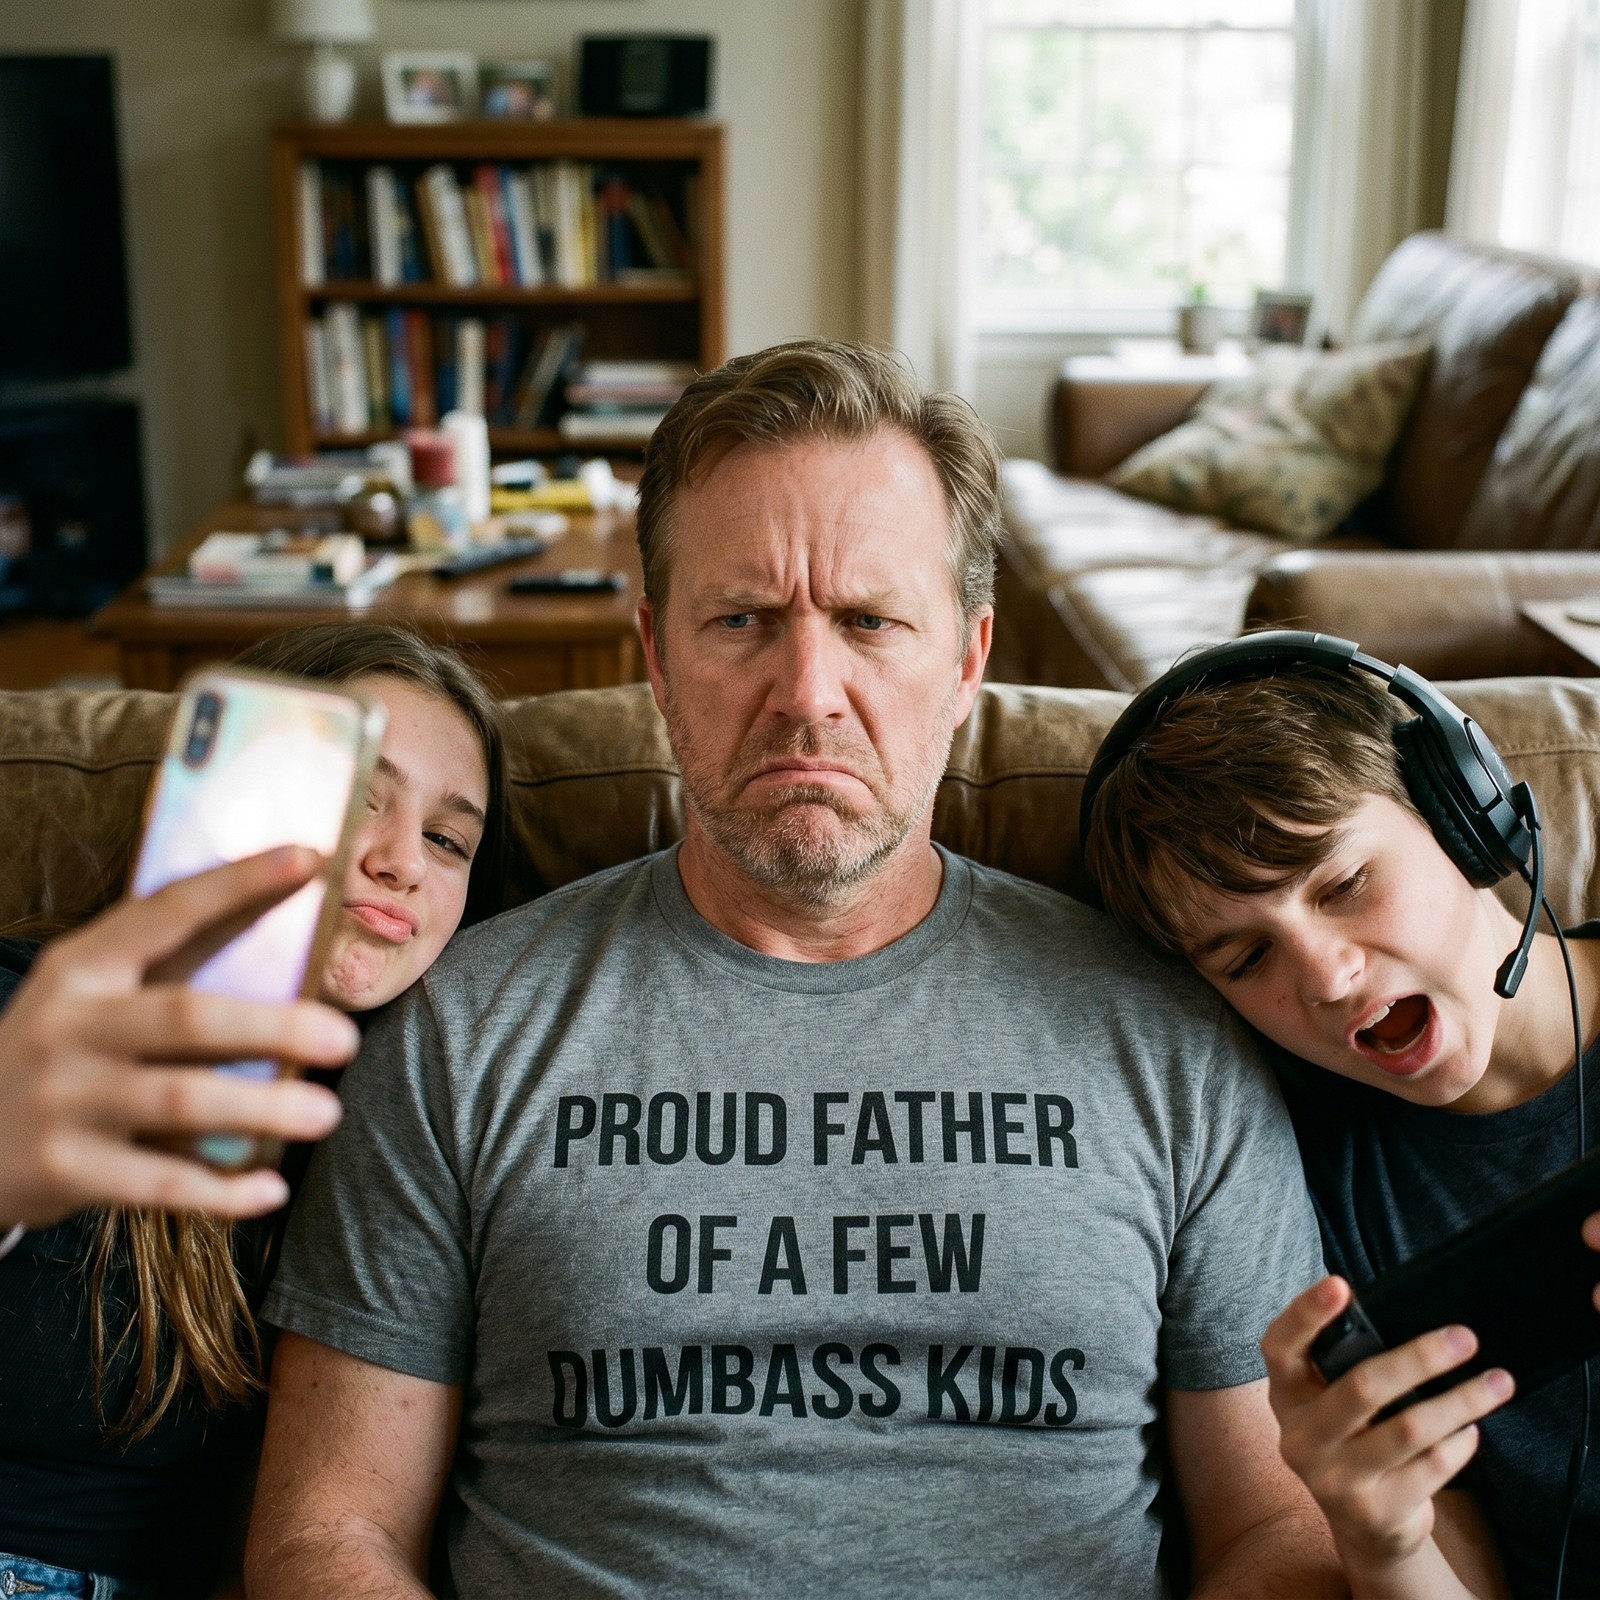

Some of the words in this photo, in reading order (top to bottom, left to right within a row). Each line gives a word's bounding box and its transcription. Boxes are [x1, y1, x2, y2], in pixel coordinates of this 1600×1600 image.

[553, 1091, 788, 1168] PROUD
[813, 1091, 1080, 1169] FATHER
[646, 1213, 738, 1294] OF
[757, 1215, 808, 1295] A
[832, 1213, 986, 1295] FEW
[547, 1342, 901, 1429] DUMBASS
[926, 1344, 1086, 1426] KIDS
